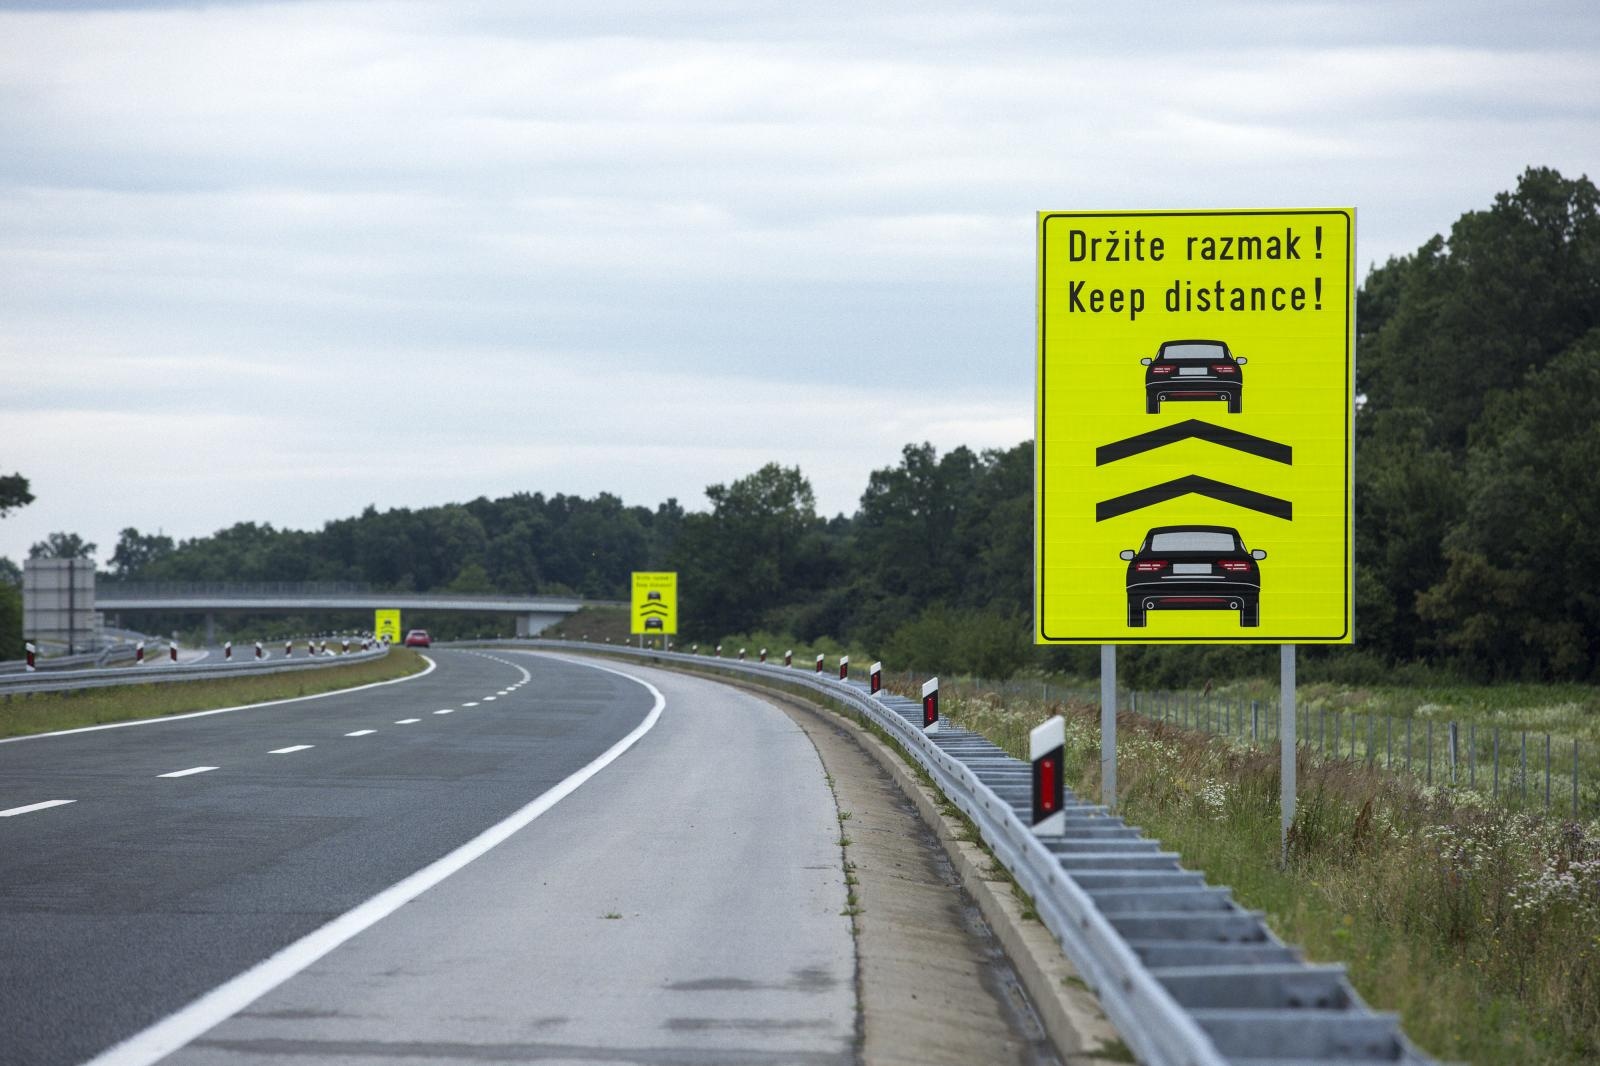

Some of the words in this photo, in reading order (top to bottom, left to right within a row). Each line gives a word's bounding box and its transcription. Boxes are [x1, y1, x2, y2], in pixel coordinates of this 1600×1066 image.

[1069, 229, 1165, 262] Držite
[1187, 227, 1301, 261] razmak
[1069, 280, 1145, 322] Keep
[1165, 276, 1322, 313] distance!
